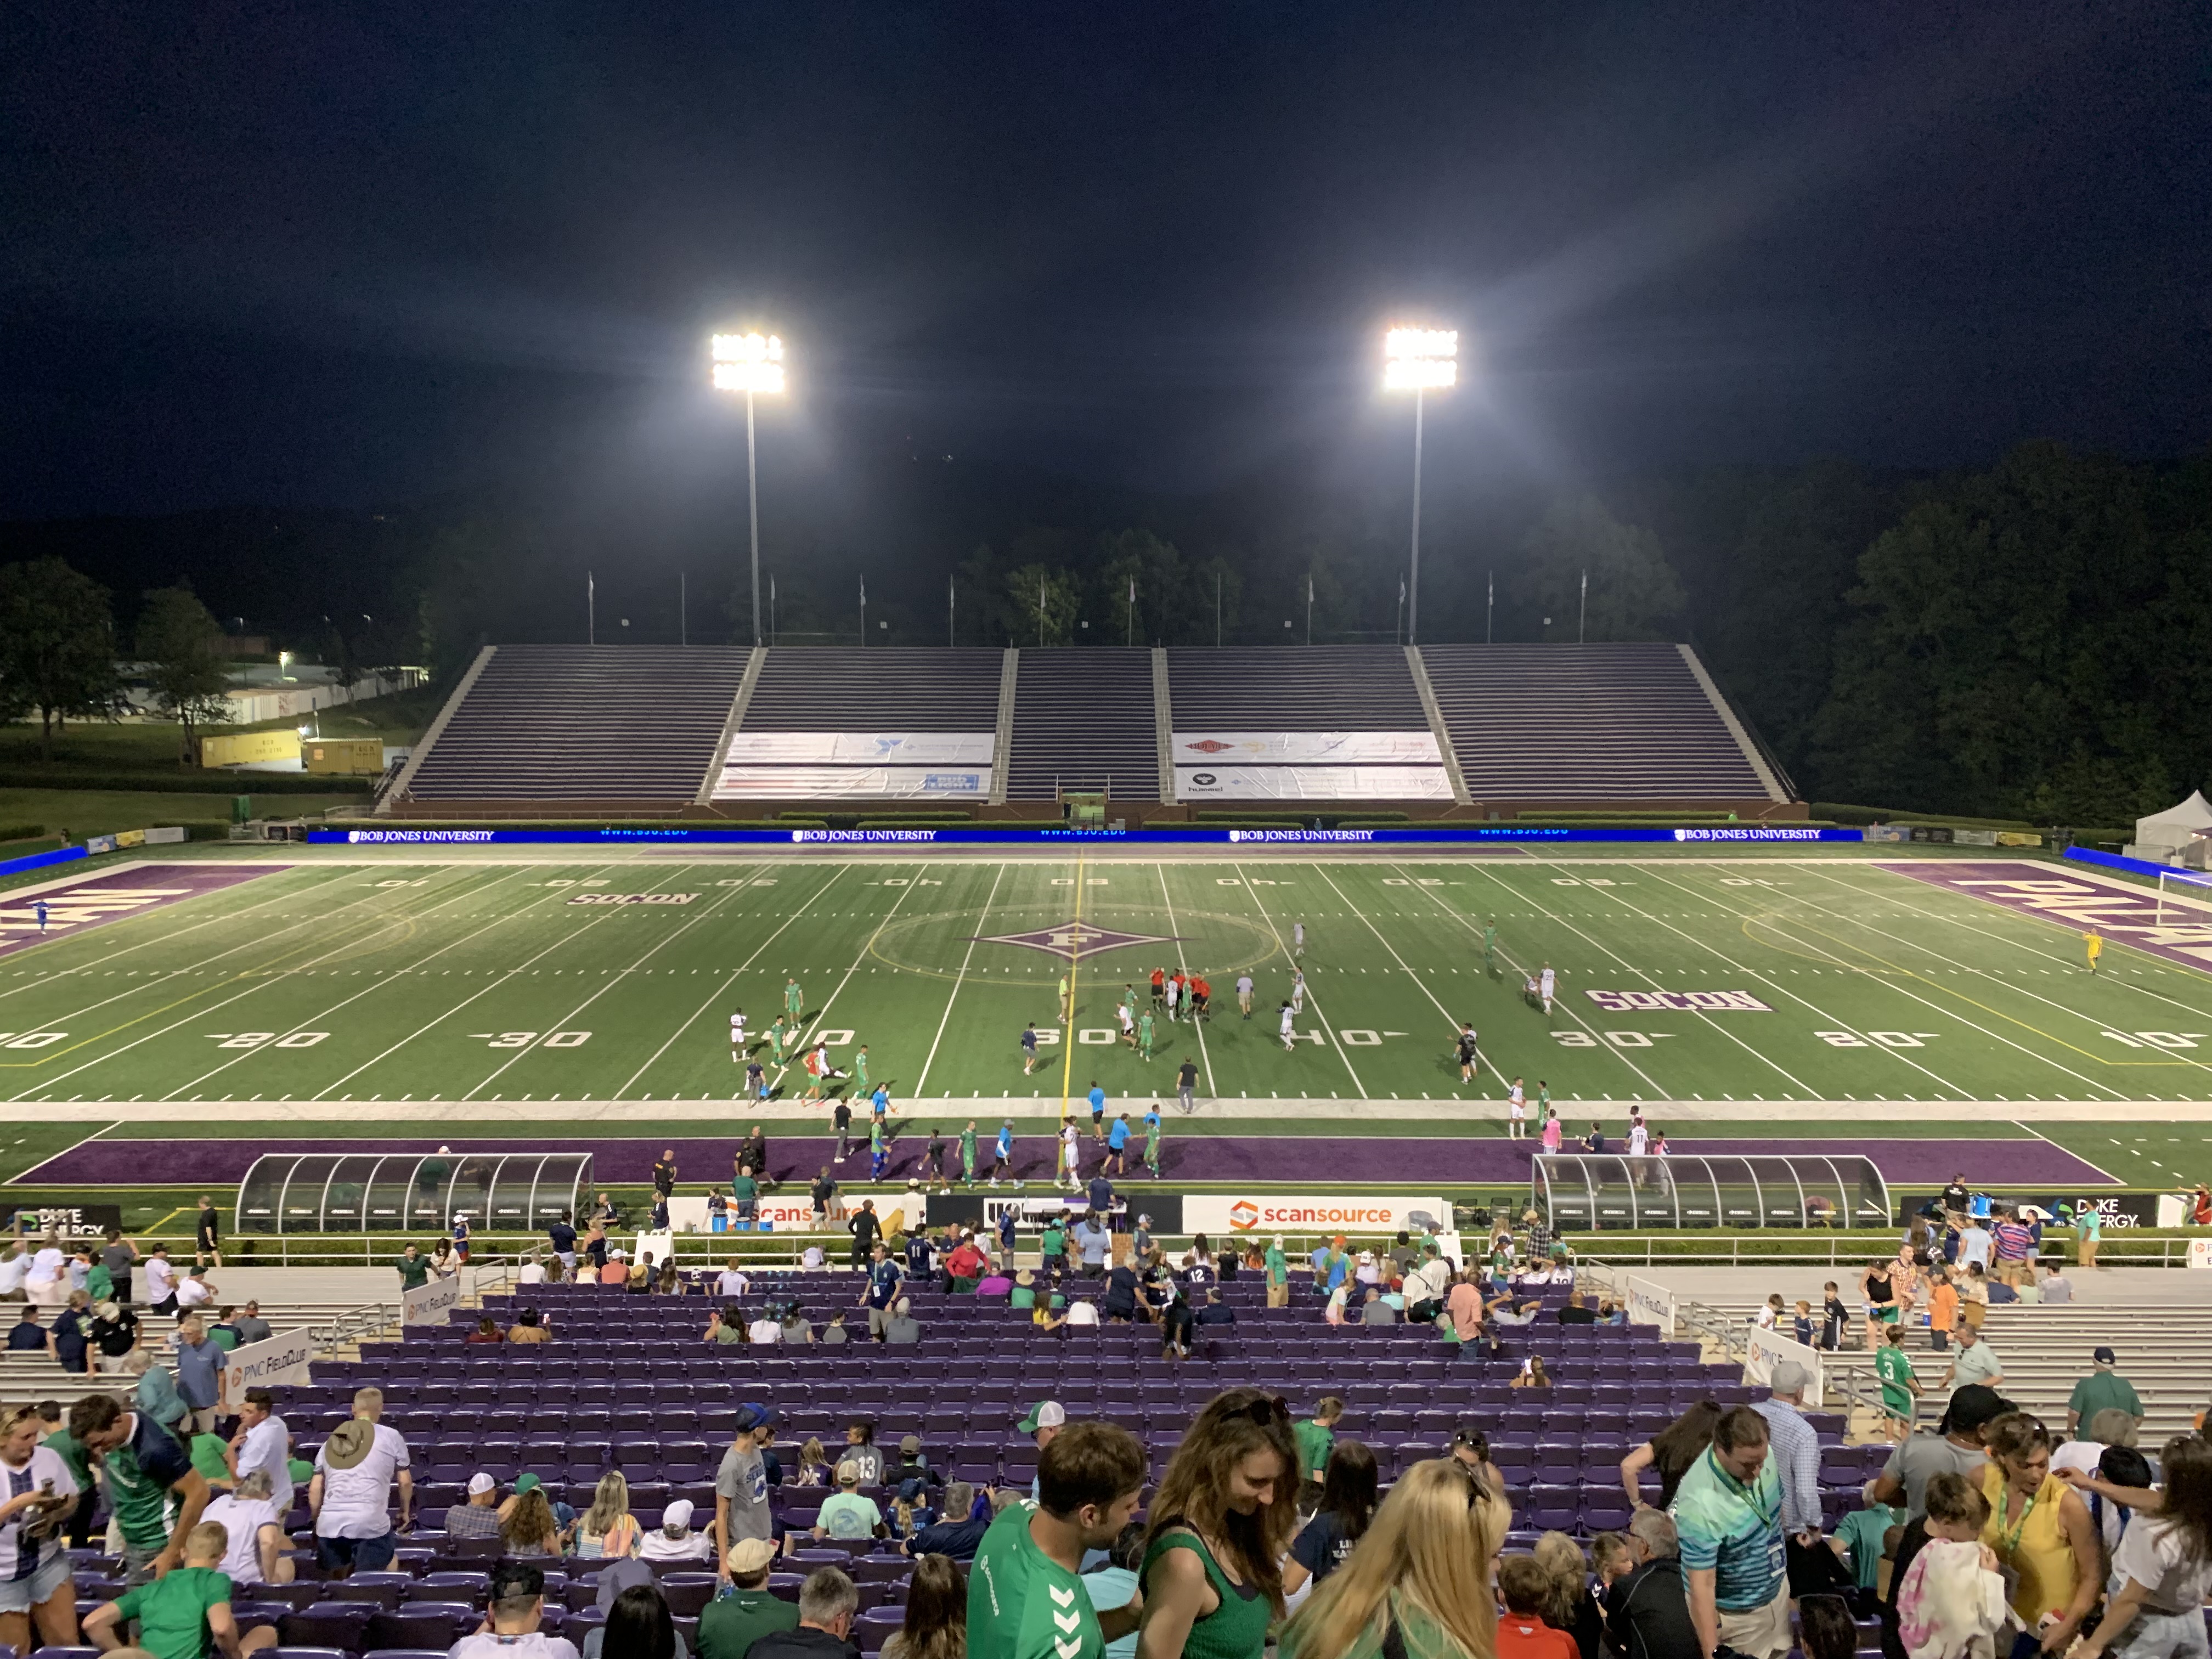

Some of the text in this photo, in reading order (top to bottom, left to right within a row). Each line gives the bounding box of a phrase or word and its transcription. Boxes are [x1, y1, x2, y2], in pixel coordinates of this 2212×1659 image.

[360, 831, 494, 843] BOB JONES UNIVERSITY
[804, 831, 936, 842] BOB JONES UNIVERSITY
[1240, 831, 1374, 841] BOB JONES UNIVERSITY
[1686, 830, 1821, 840] BOB JONES UNIVERSITY
[1047, 933, 1102, 946] F
[218, 1032, 331, 1047] 20
[488, 1031, 592, 1047] 30
[1550, 1031, 1654, 1047] 30
[1814, 1031, 1926, 1047] 20
[2100, 1032, 2198, 1047] 10
[1637, 1135, 1643, 1143] 11
[2076, 1199, 2119, 1213] DKE
[1264, 1207, 1392, 1223] scansource
[2076, 1214, 2138, 1228] ERGY
[911, 1245, 921, 1257] 11
[1190, 1268, 1205, 1283] 12
[1634, 1291, 1646, 1307] PNC
[416, 1302, 430, 1316] PNC
[1761, 1348, 1776, 1365] PNC
[244, 1360, 265, 1382] PNC
[1884, 1361, 1894, 1380] 3
[858, 1455, 876, 1480] 13
[895, 1522, 926, 1531] WKER
